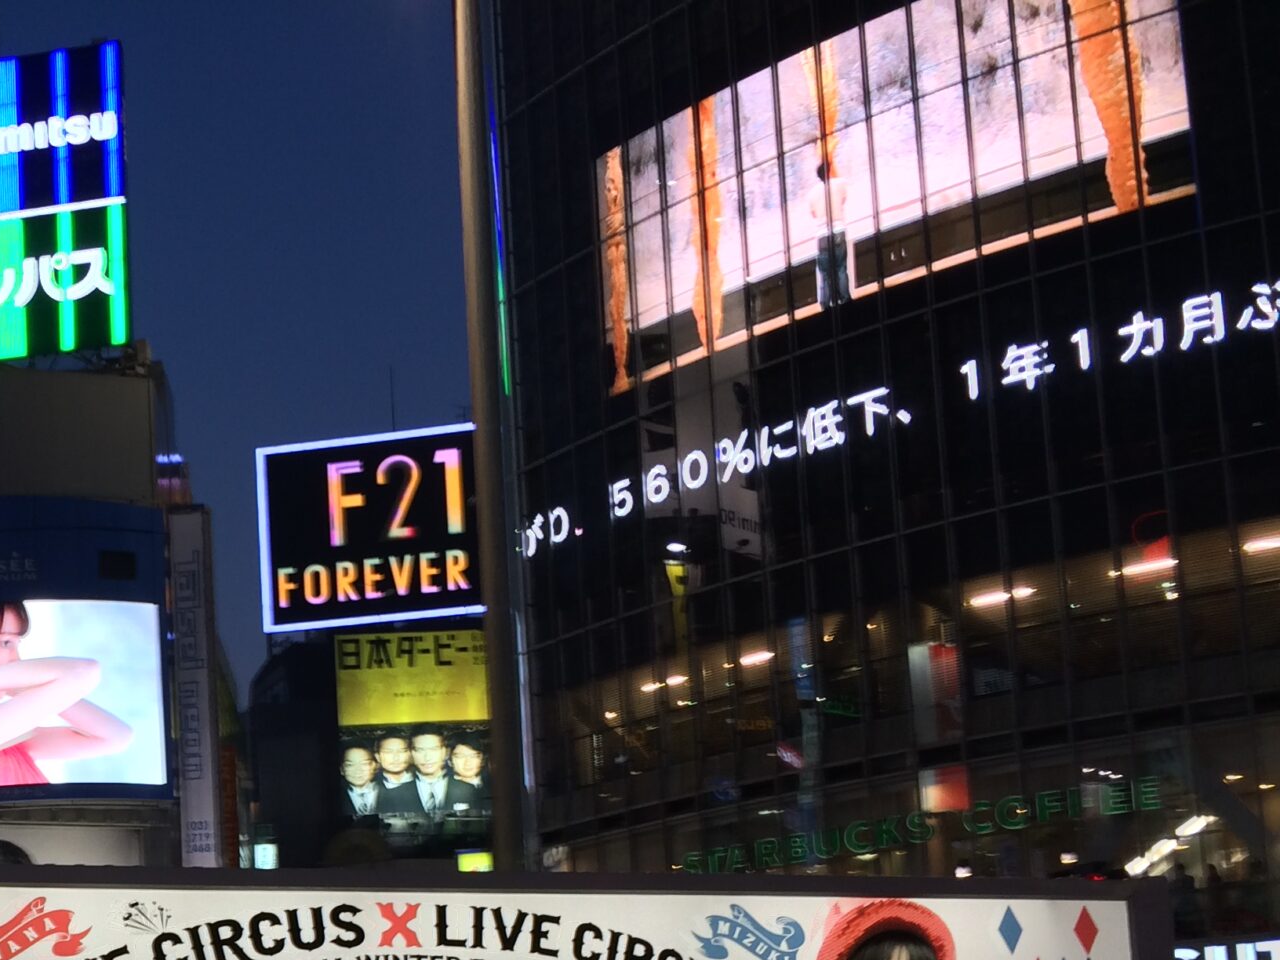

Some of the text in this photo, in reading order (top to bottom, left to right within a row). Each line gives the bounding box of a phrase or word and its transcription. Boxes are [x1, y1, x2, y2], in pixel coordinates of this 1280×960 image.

[326, 447, 468, 548] F21
[276, 549, 472, 608] FOREVER
[336, 634, 468, 670] 日本ダービー
[682, 775, 1162, 874] STARBUCKS COFFEE
[434, 903, 562, 960] LIVE
